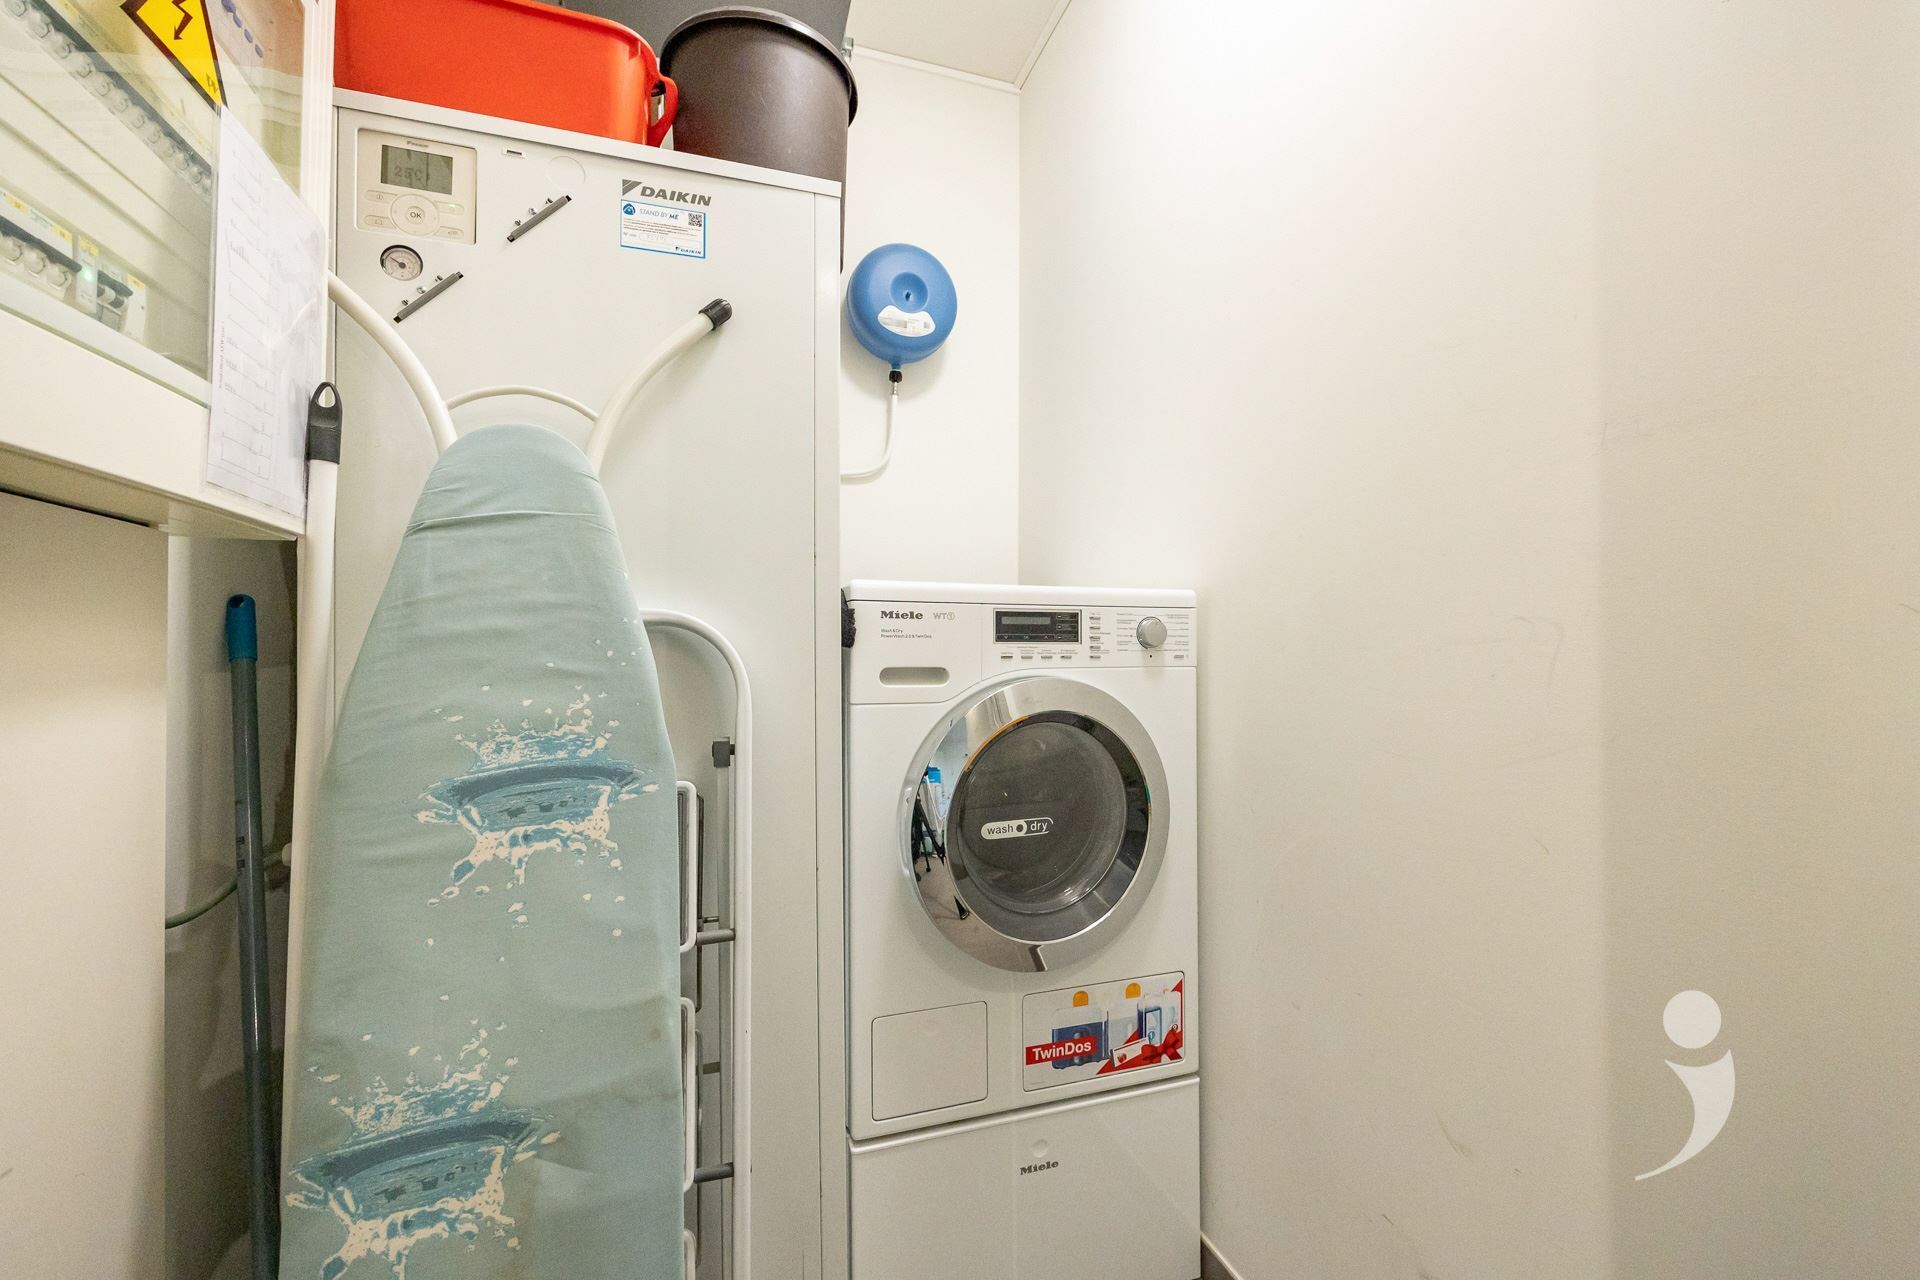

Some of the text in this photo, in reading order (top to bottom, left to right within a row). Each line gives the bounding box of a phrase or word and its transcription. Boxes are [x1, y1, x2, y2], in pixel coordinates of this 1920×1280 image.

[640, 186, 711, 206] DAIKIN
[639, 208, 660, 217] STAND
[880, 610, 924, 620] Miele
[987, 820, 1048, 835] wash dry
[1032, 1040, 1092, 1061] TwinDos
[1020, 1161, 1059, 1176] Miele
